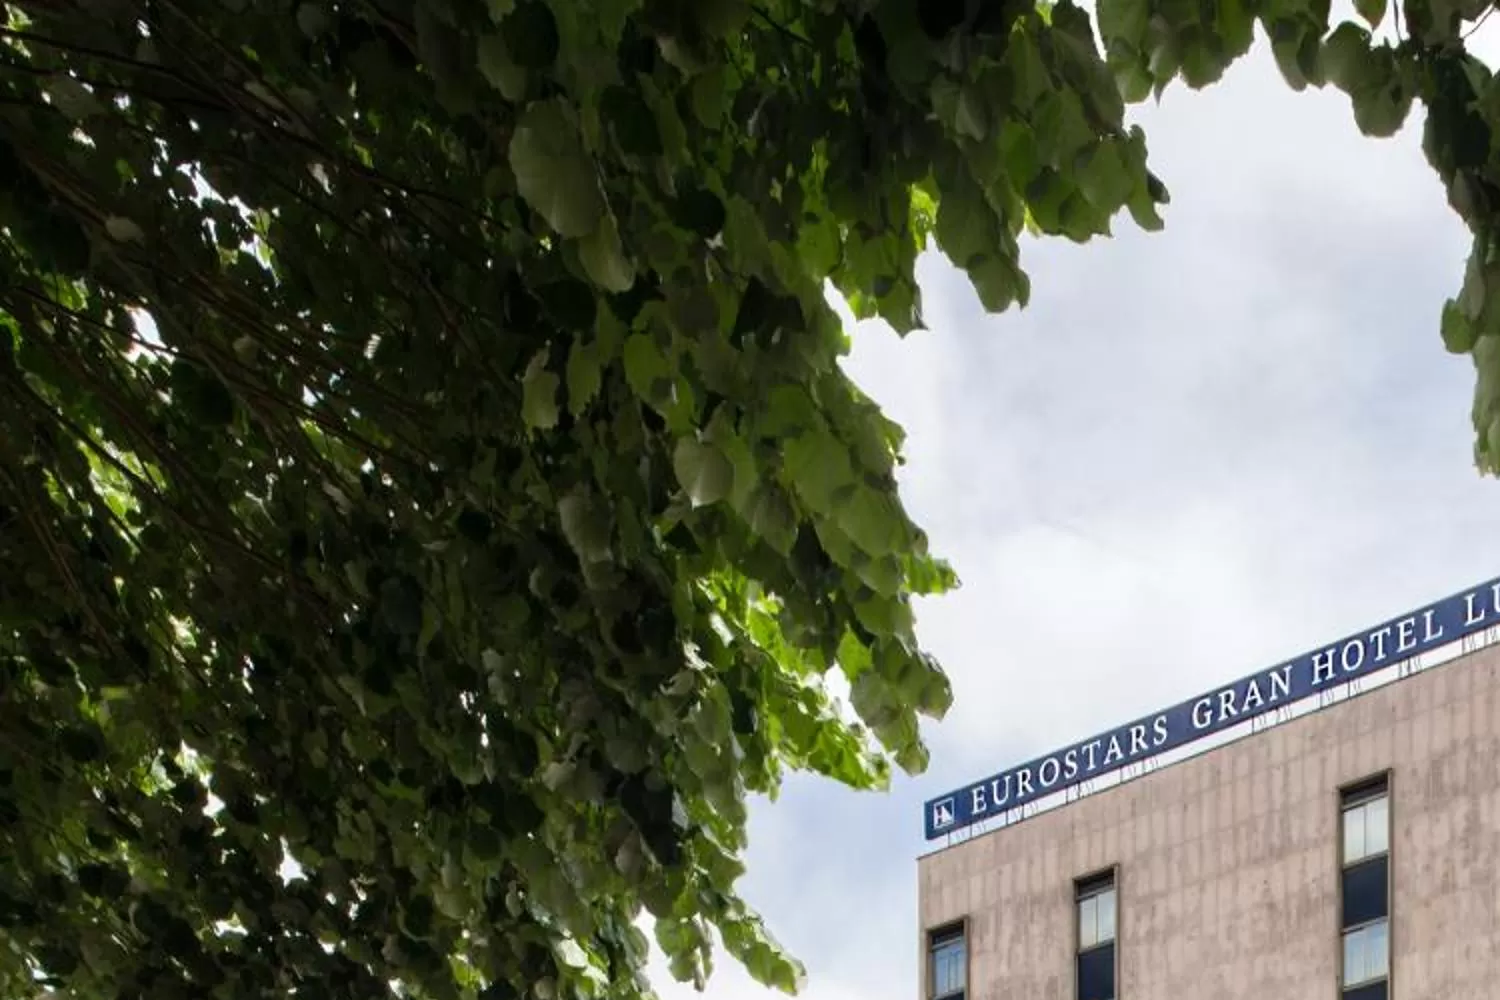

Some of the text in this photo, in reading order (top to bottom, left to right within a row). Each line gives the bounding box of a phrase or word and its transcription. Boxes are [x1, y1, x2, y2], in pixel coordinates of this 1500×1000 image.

[970, 714, 1168, 815] EUROSTARS
[1191, 664, 1293, 729] GRAN
[1311, 609, 1443, 685] HOTEL
